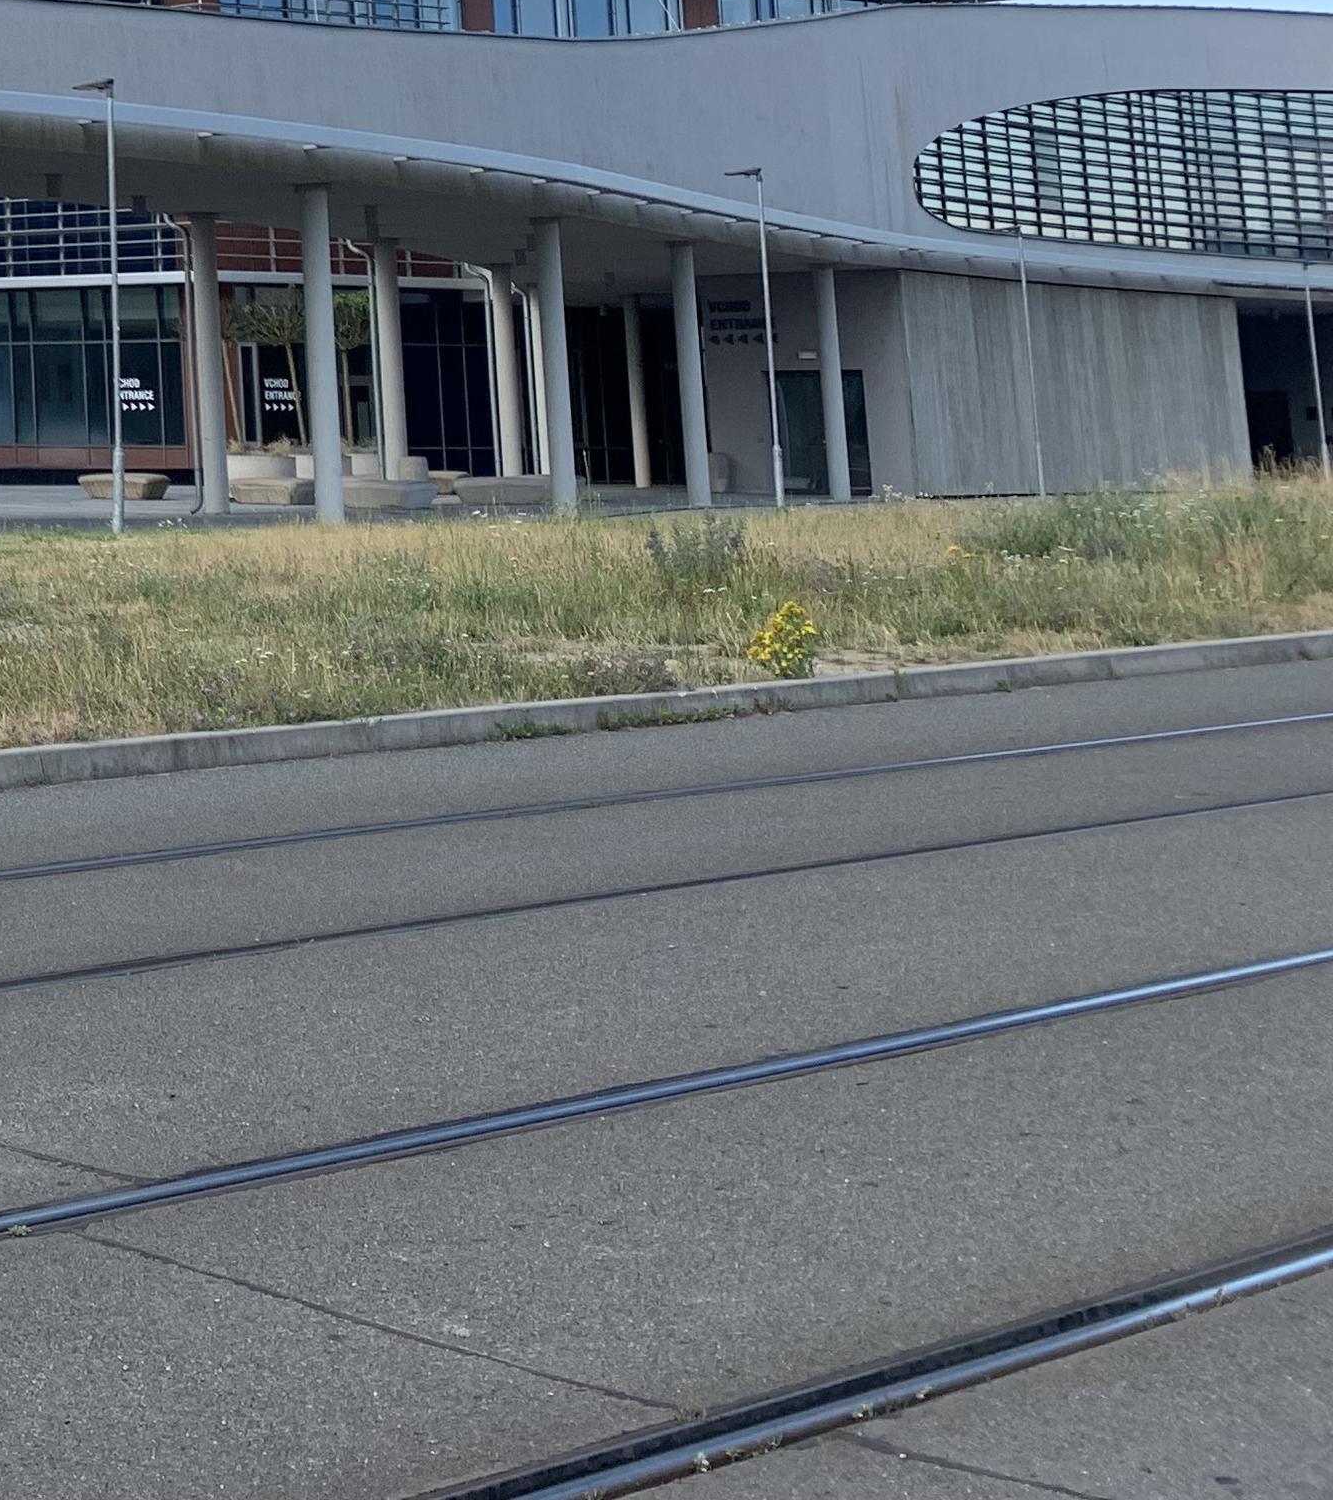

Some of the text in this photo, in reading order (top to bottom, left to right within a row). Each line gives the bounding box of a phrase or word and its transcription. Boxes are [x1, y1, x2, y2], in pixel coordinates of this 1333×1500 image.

[118, 377, 140, 388] CHOD
[264, 377, 289, 388] VCHOD
[119, 390, 155, 401] NTRANCE
